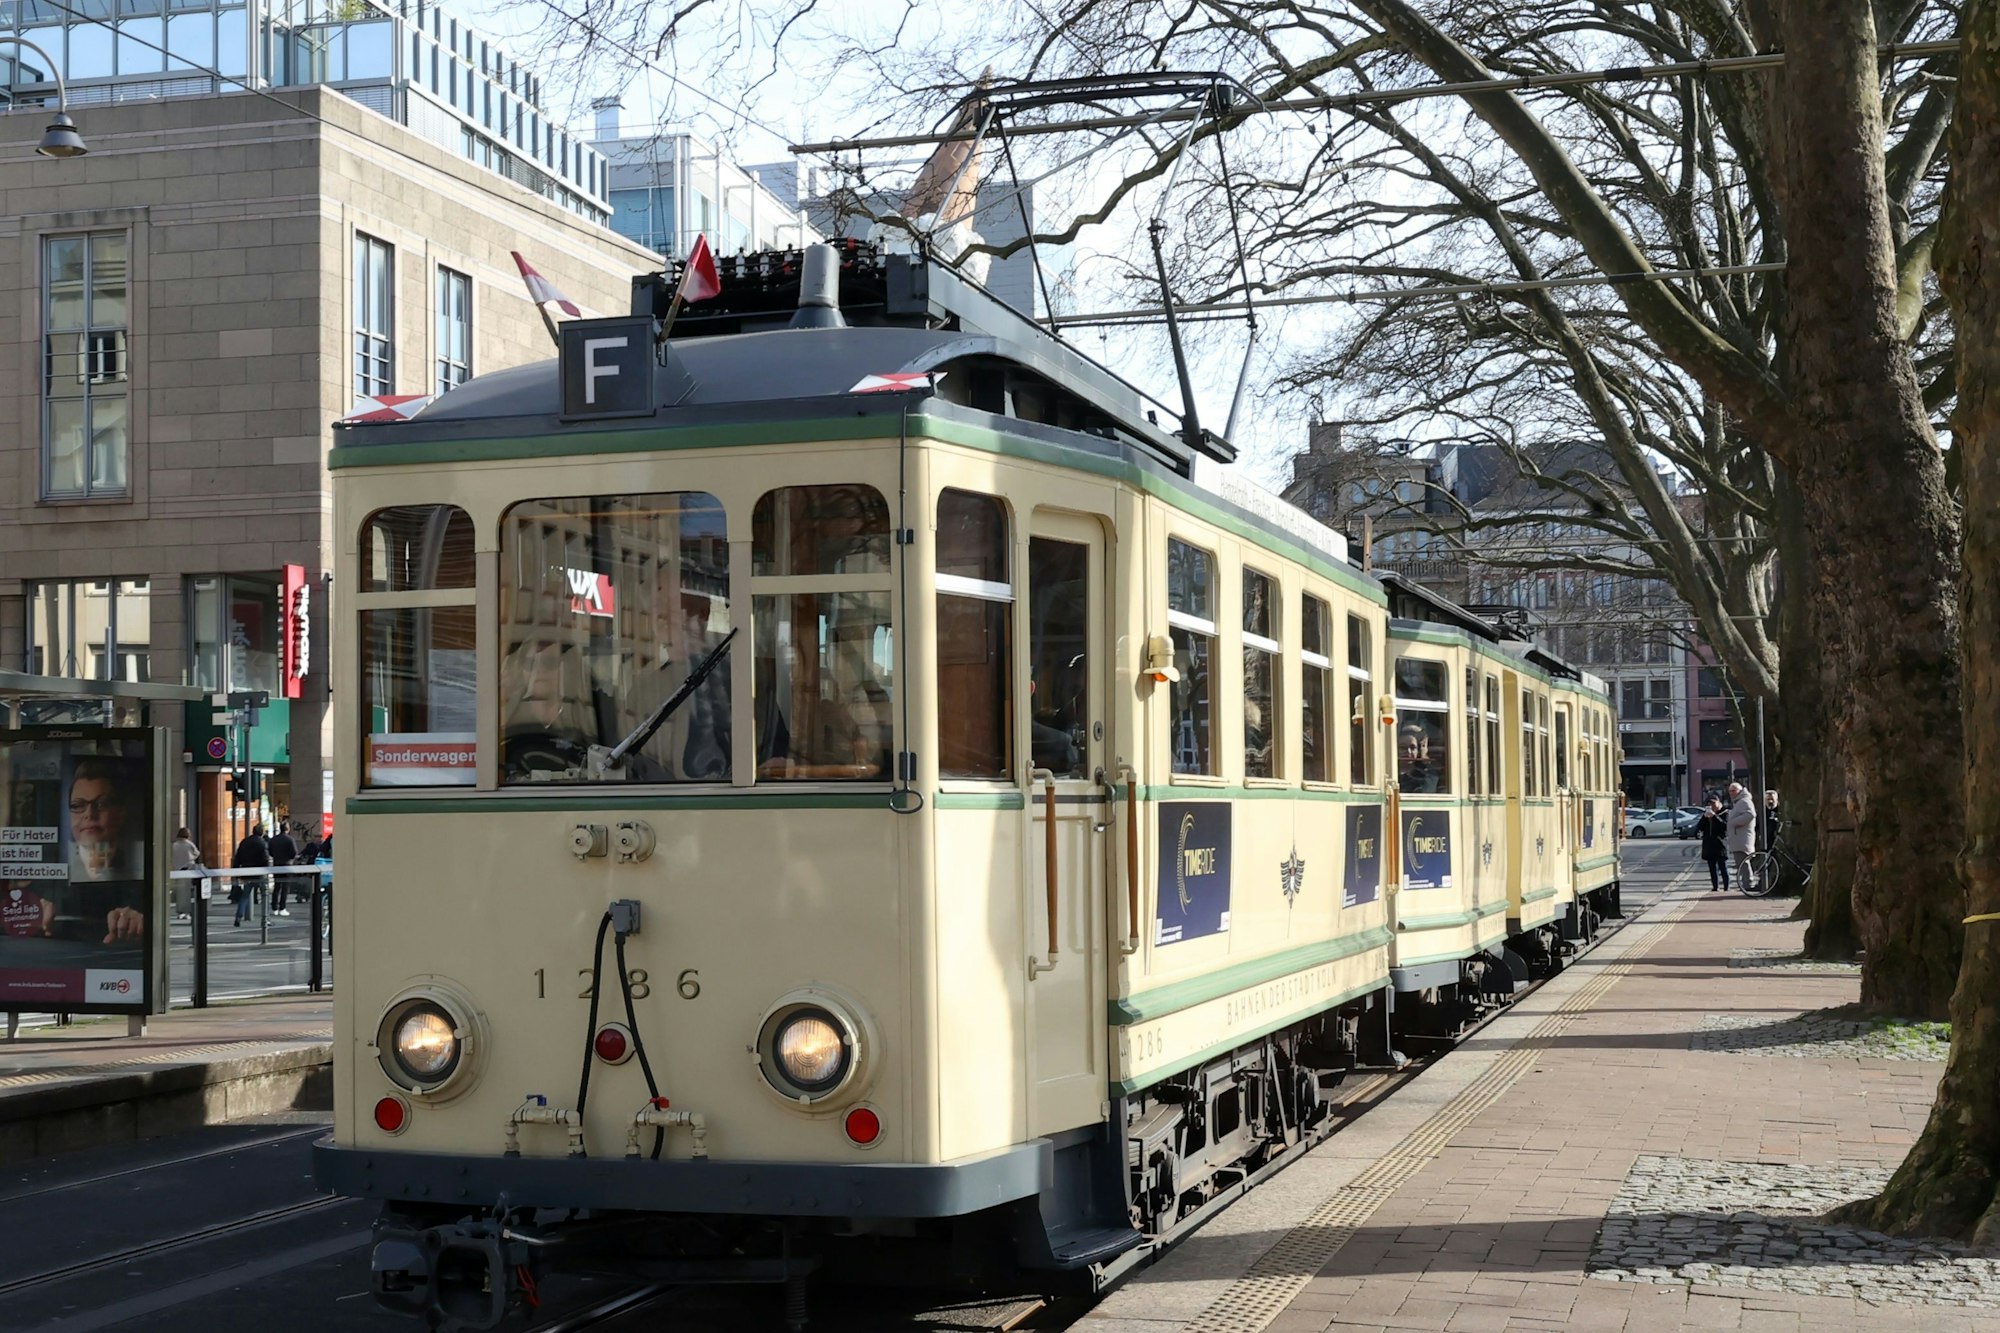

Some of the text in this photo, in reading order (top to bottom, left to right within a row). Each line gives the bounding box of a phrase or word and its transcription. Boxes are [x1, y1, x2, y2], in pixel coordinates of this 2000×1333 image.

[584, 336, 629, 404] F
[375, 749, 477, 765] Sonderwagen
[227, 807, 257, 820] DEPT
[2, 829, 55, 840] Für Hater
[2, 847, 40, 858] ist hier
[2, 866, 66, 877] Endstation.
[3, 904, 40, 915] Seid lieb
[99, 981, 117, 991] KVB
